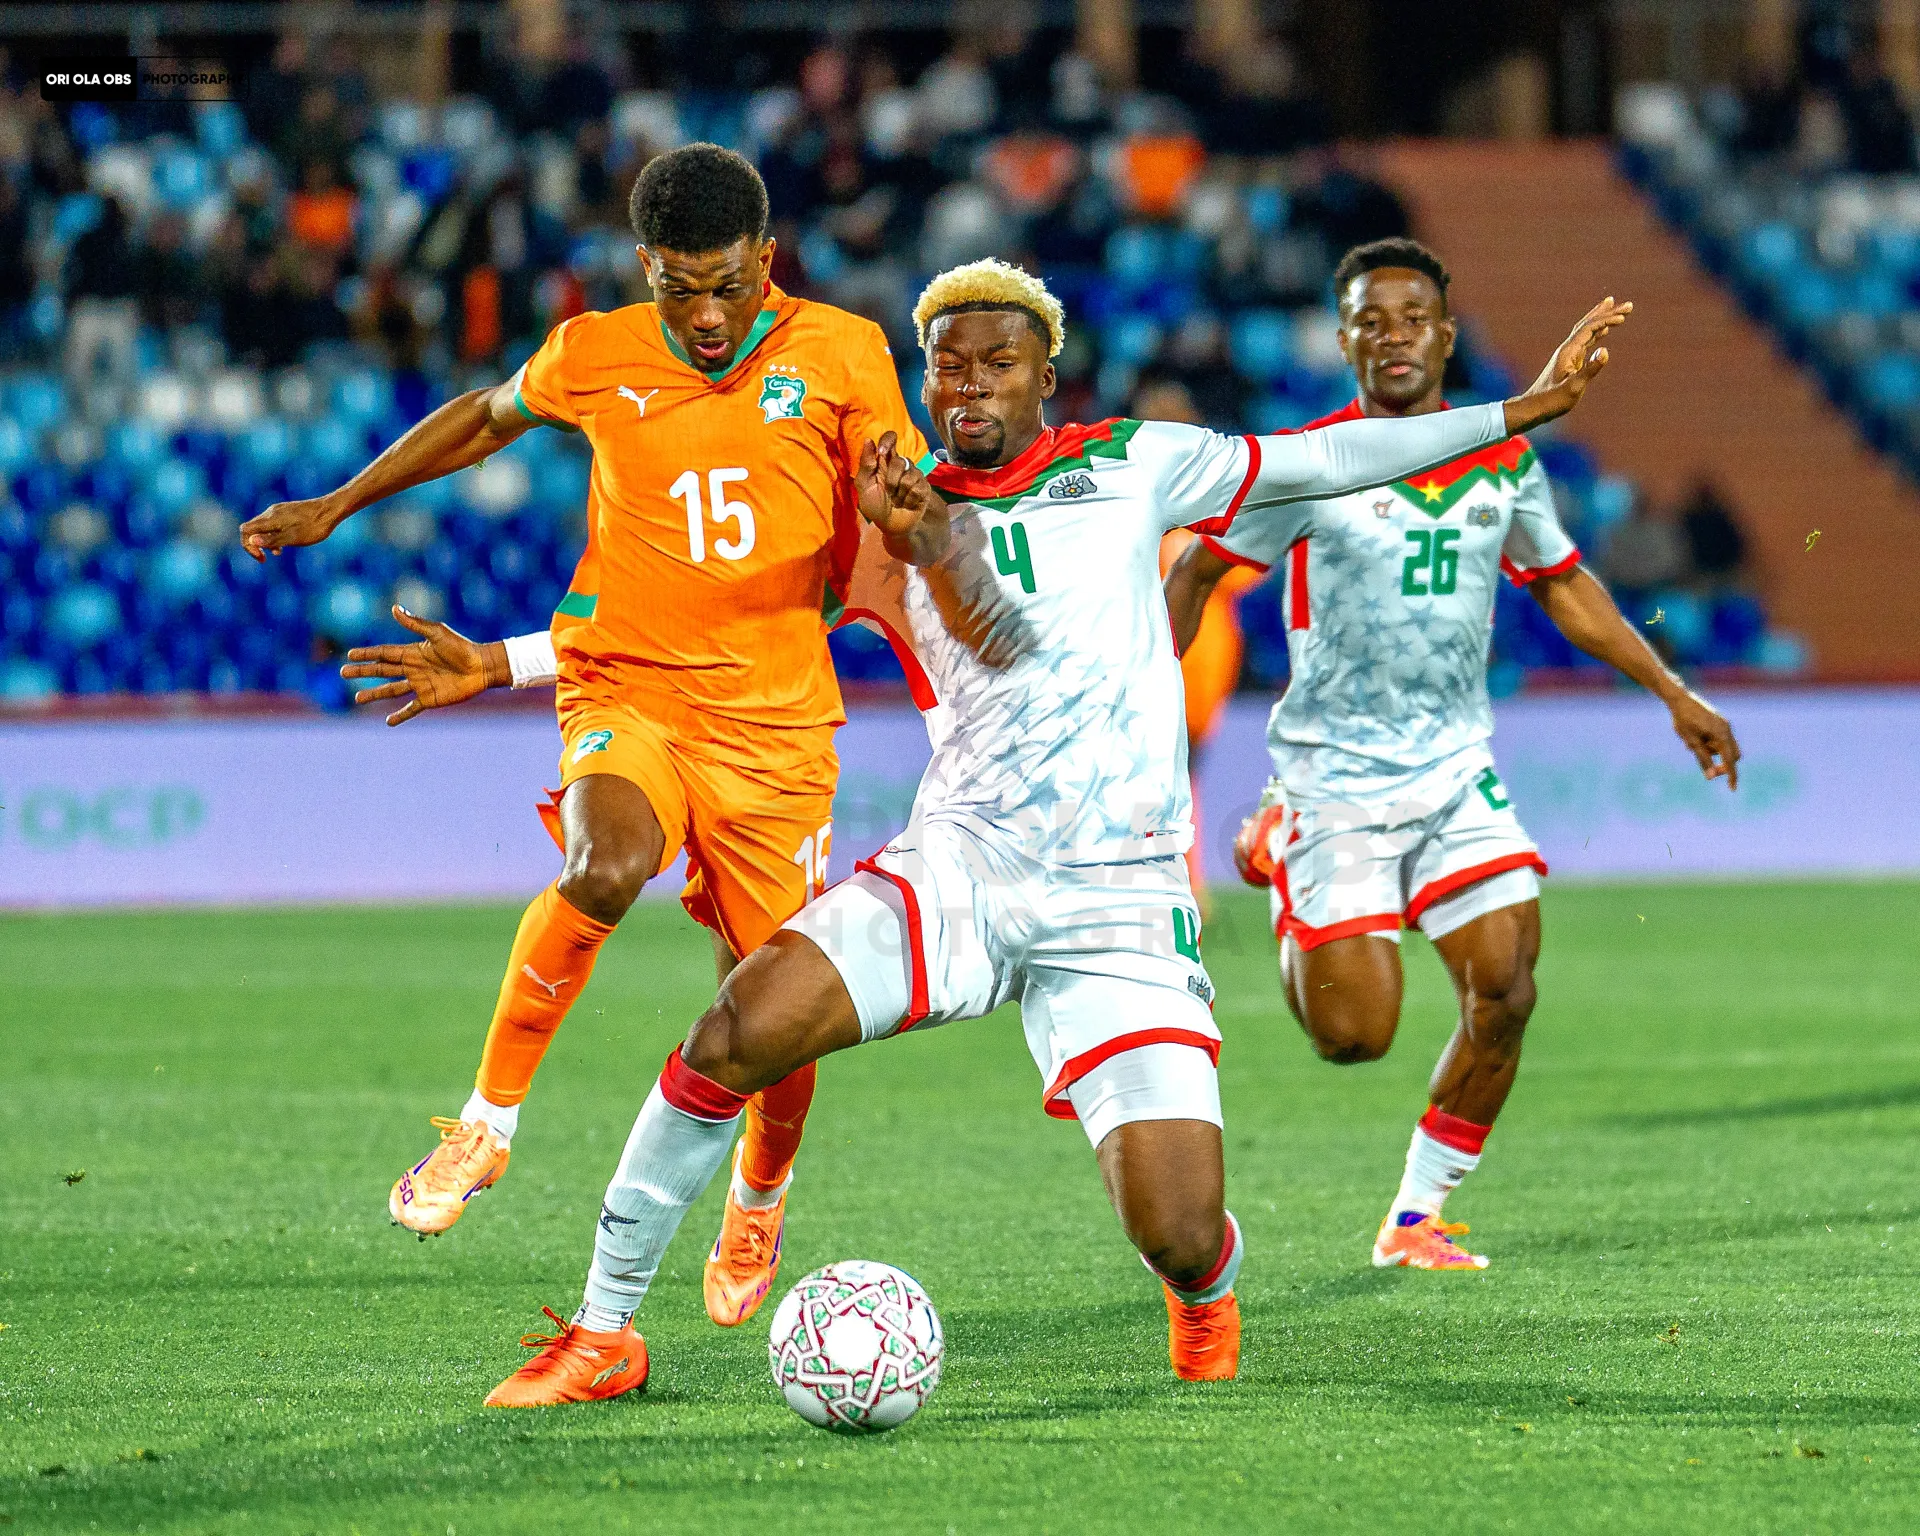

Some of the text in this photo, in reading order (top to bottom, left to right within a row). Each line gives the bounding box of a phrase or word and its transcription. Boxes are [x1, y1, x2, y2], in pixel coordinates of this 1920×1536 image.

[669, 467, 757, 563] 15
[990, 521, 1037, 594] 4
[1401, 528, 1461, 596] 26
[19, 783, 207, 851] OCP
